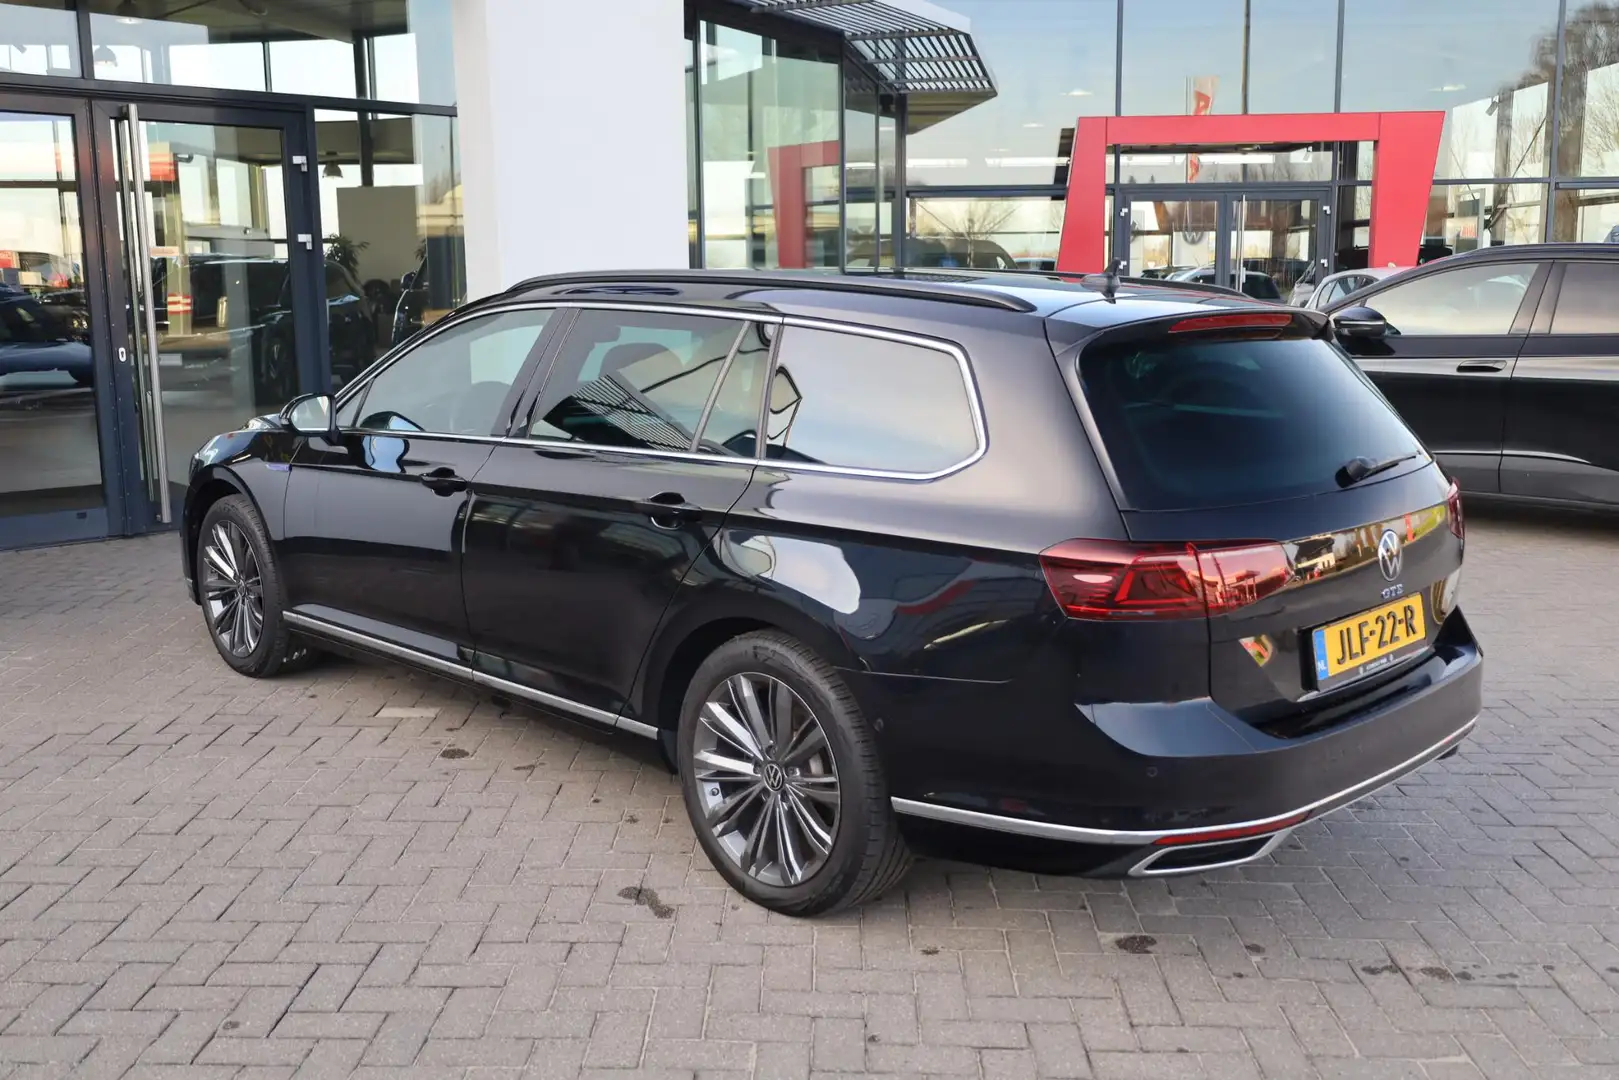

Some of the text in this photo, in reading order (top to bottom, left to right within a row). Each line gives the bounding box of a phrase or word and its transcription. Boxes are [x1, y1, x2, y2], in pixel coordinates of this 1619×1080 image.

[1381, 584, 1403, 599] GTE
[1336, 605, 1417, 665] JLF-22-R
[1318, 660, 1327, 671] NL
